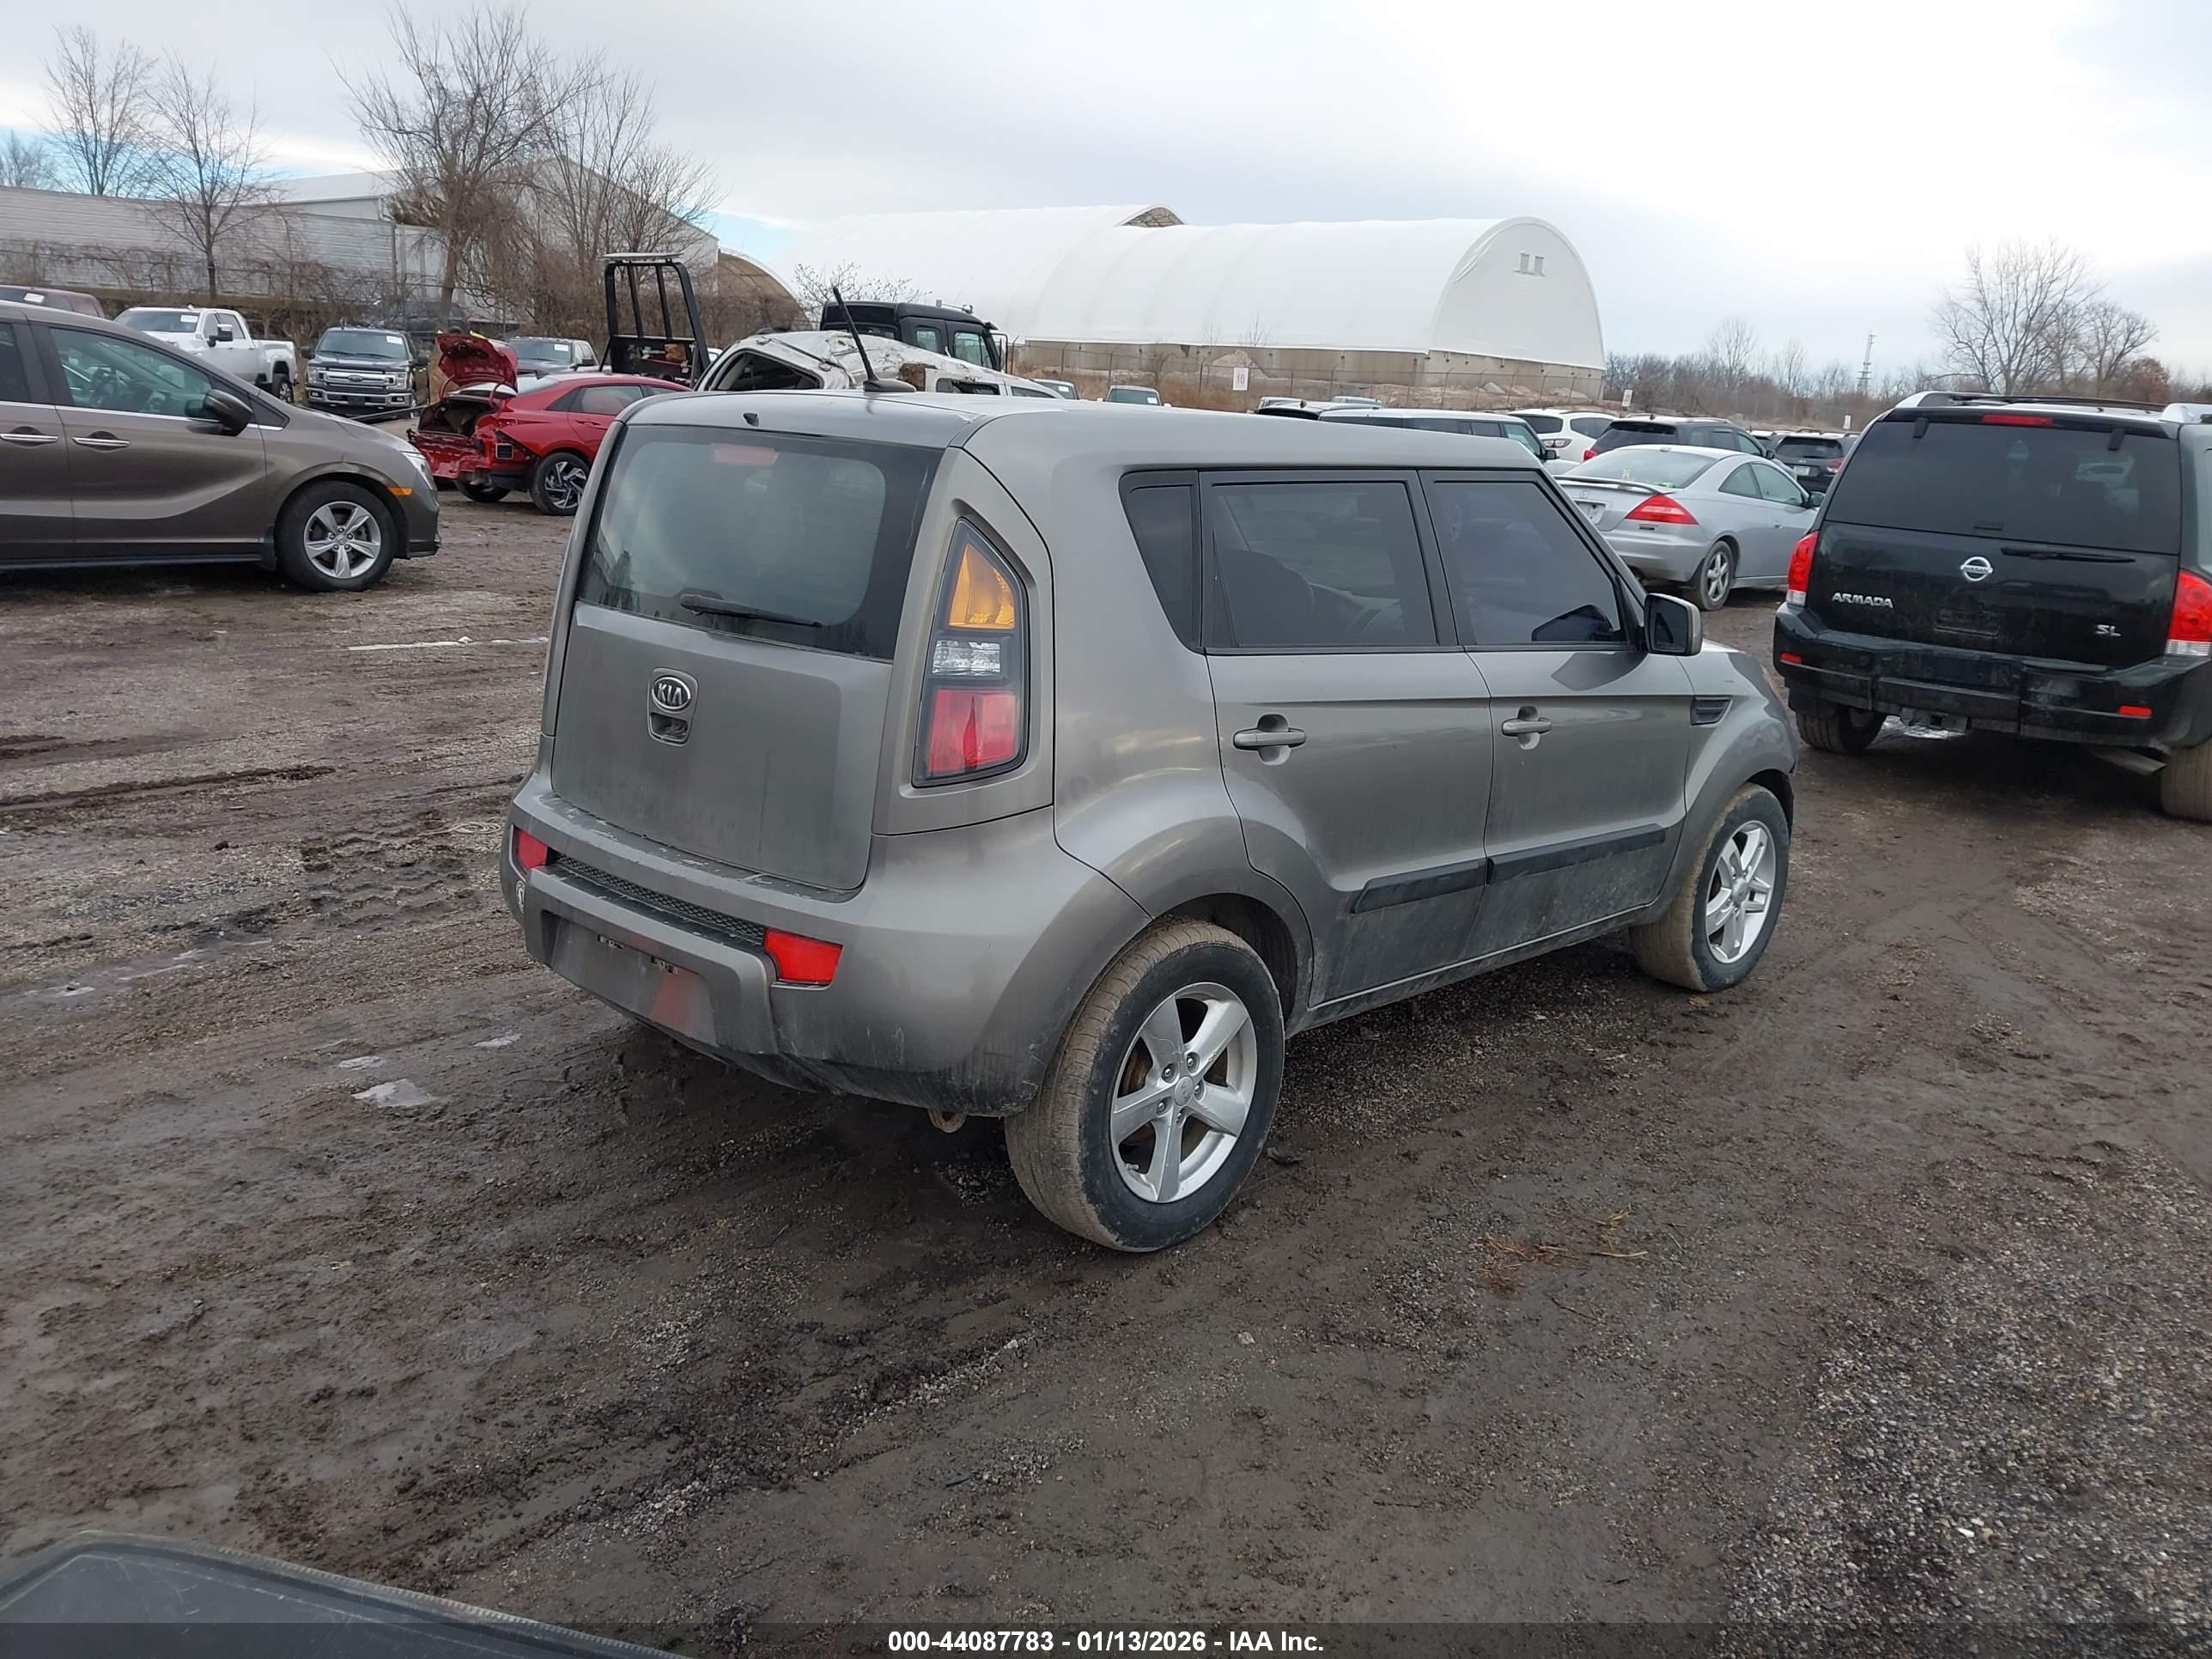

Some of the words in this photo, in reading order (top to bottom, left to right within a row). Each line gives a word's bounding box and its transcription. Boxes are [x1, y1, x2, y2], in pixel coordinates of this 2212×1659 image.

[1832, 592, 1893, 609] ARMADA
[2096, 624, 2121, 636] SL
[658, 683, 683, 705] KIA
